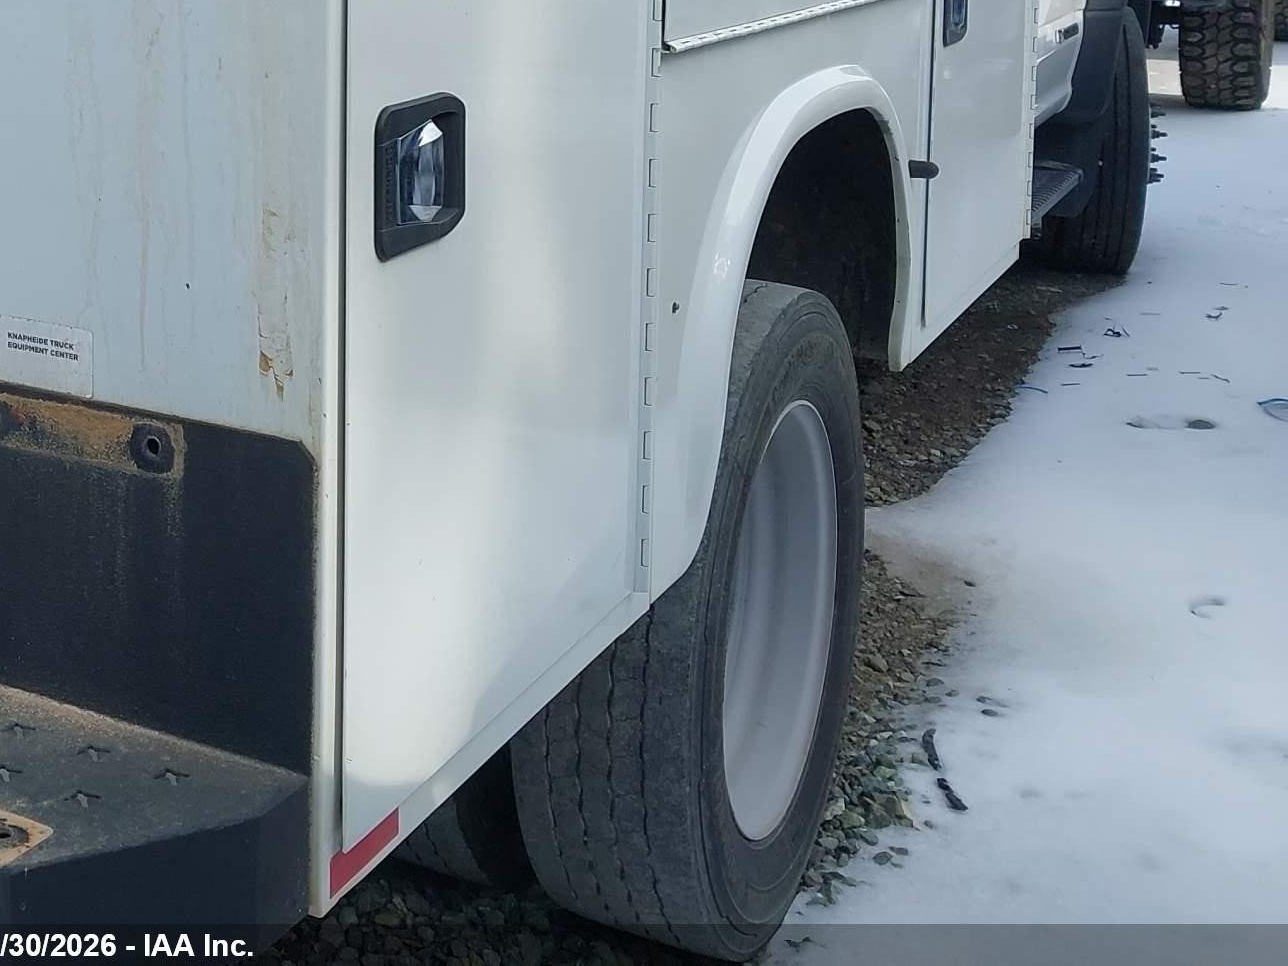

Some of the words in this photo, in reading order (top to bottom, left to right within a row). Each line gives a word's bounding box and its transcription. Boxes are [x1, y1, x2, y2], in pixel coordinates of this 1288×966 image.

[7, 332, 49, 346] KNAPHEIDE
[50, 339, 74, 350] TRUCK
[7, 341, 49, 355] EQUIPMENT
[50, 349, 79, 361] CENTER
